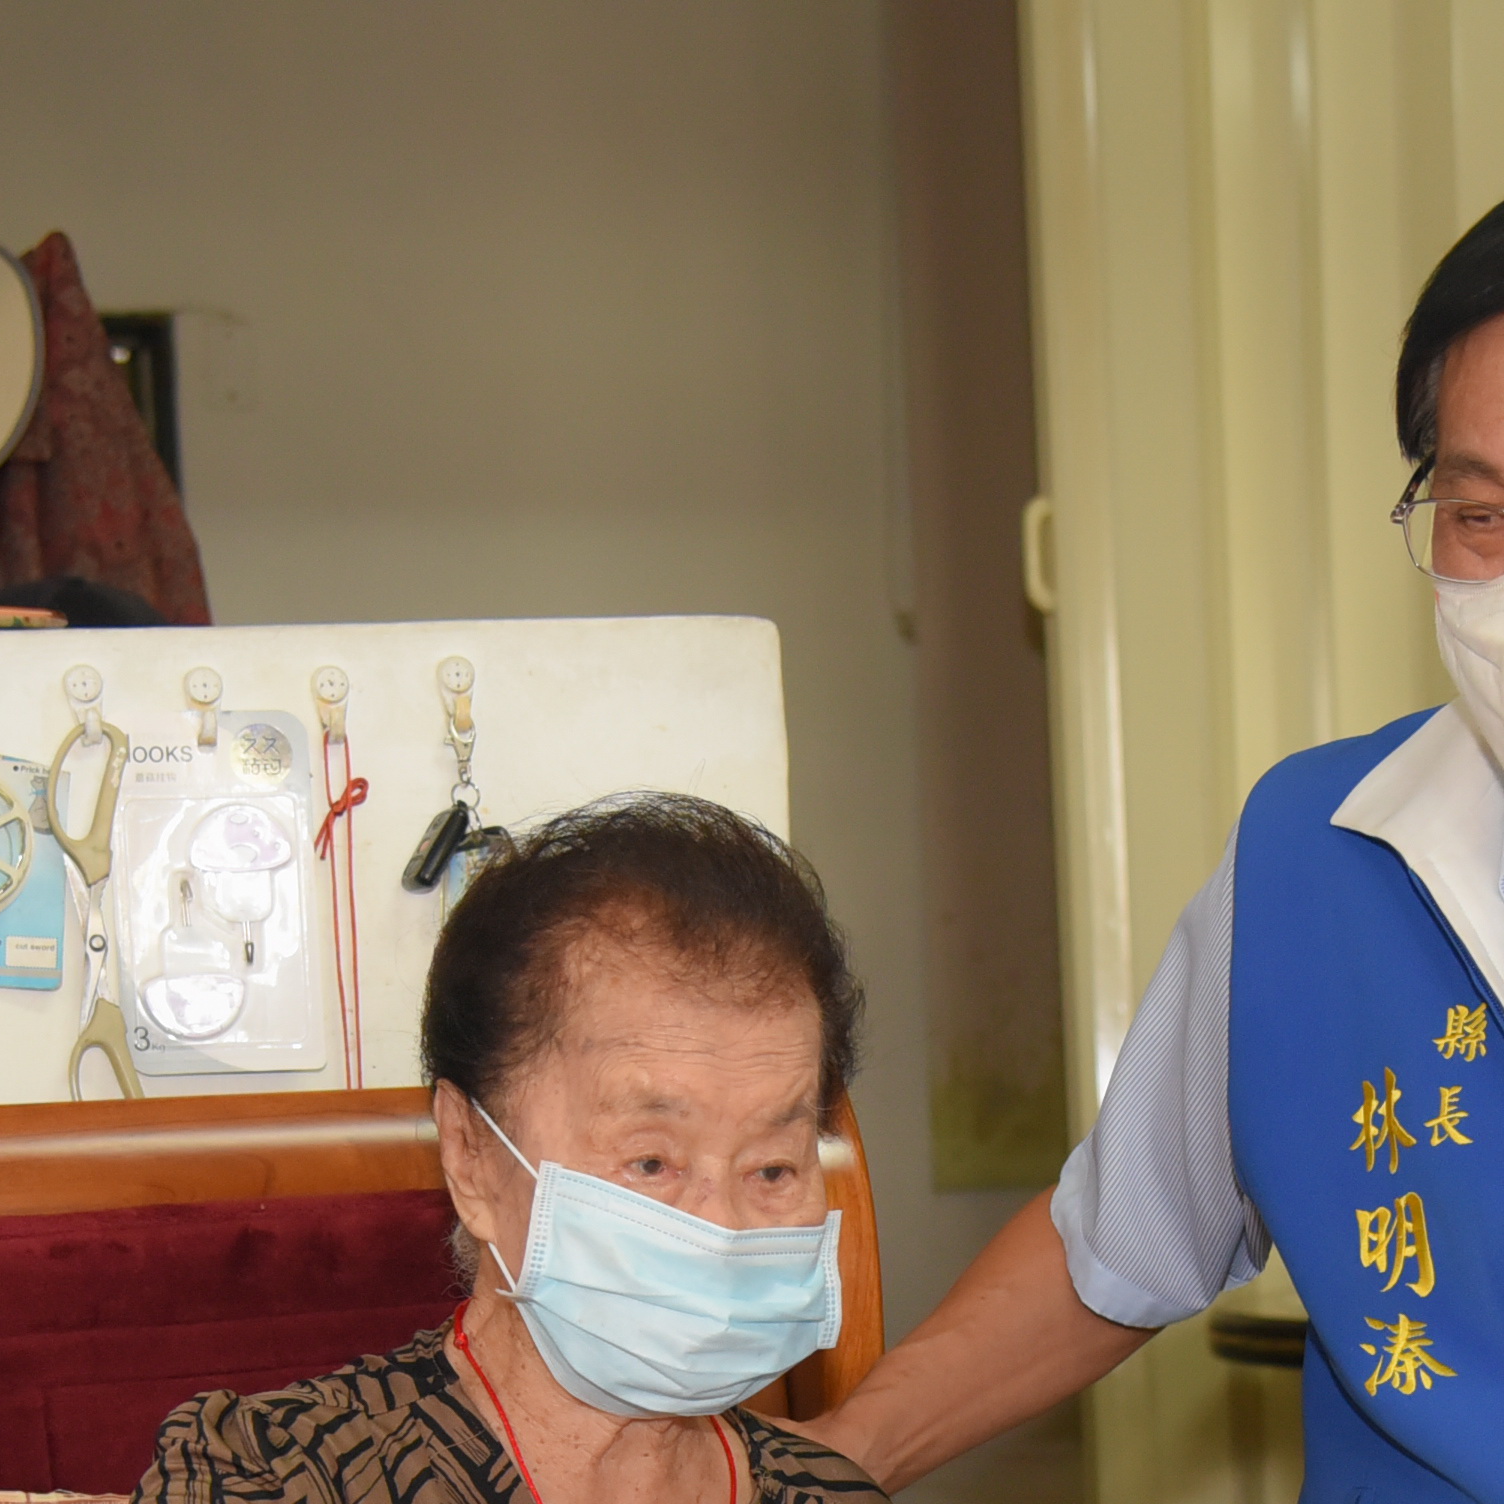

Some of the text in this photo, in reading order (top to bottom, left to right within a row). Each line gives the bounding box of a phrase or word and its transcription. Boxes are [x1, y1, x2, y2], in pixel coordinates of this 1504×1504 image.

[1423, 1002, 1489, 1147] 縣長
[1349, 1066, 1459, 1397] 林明溱
